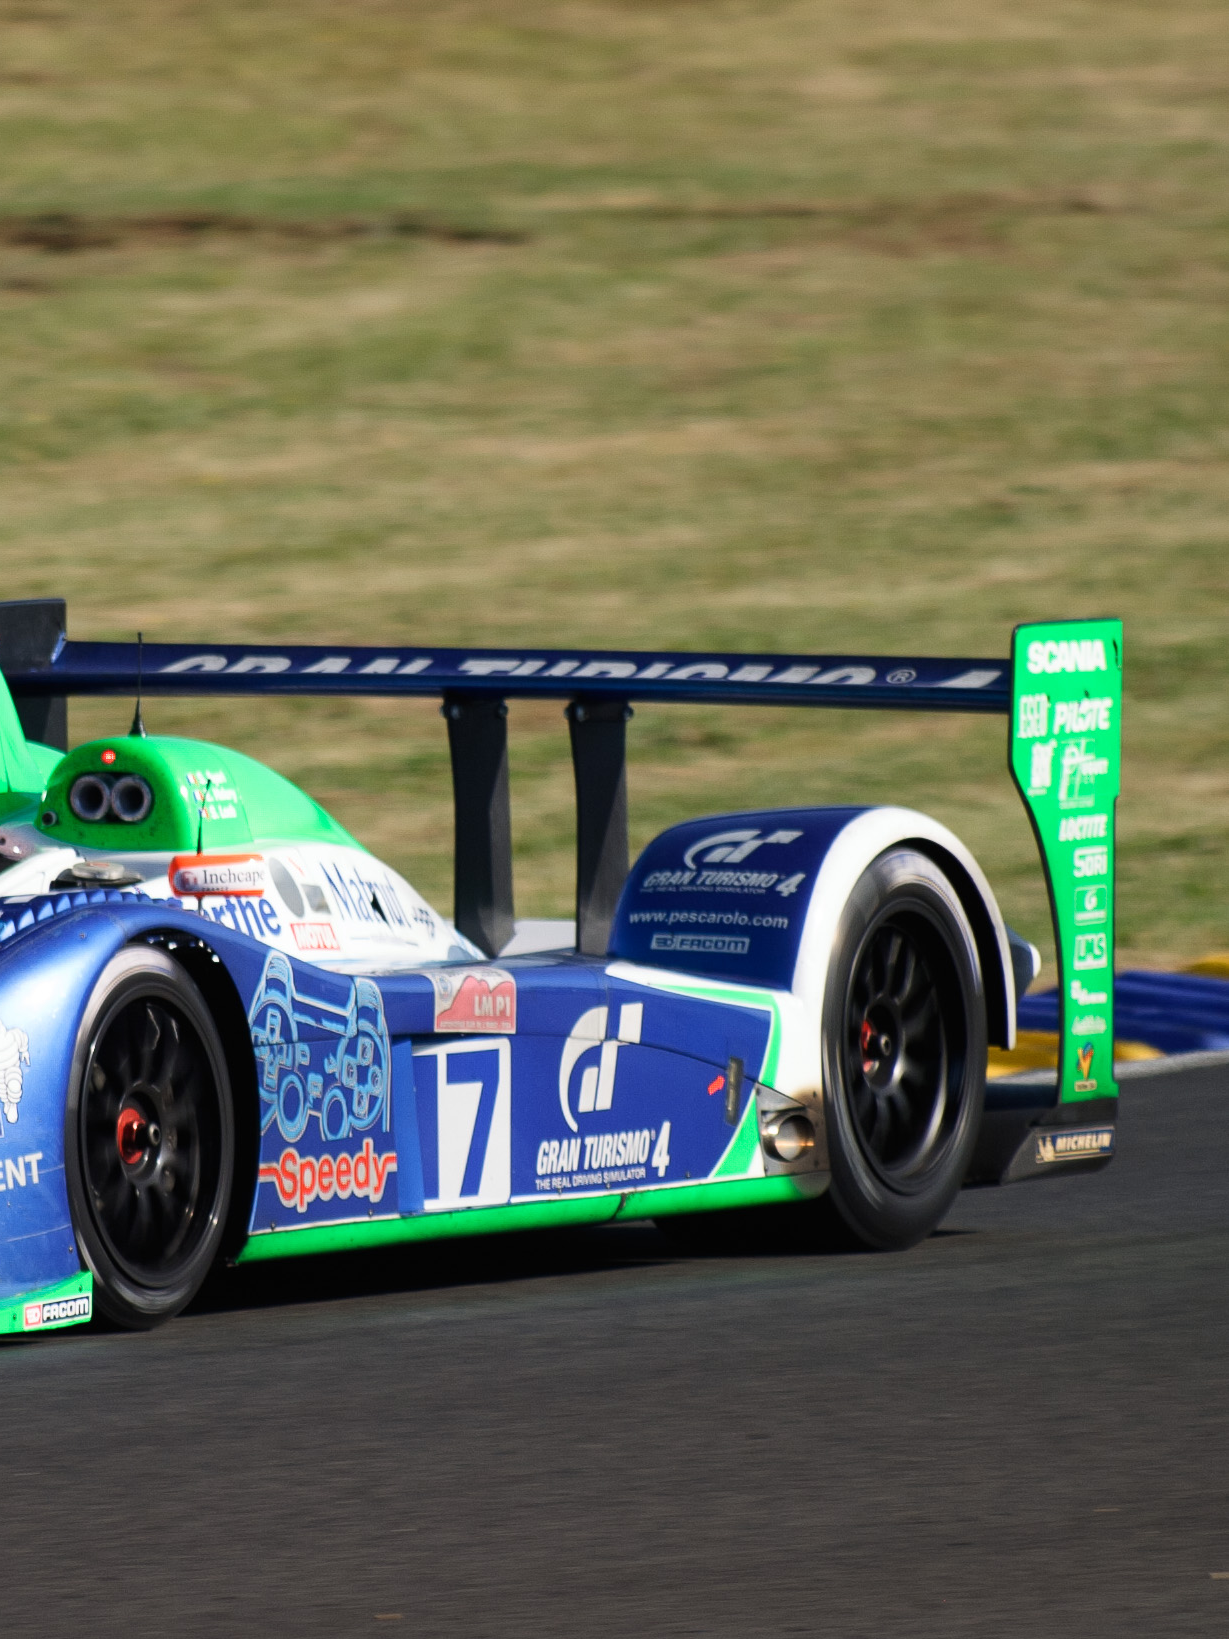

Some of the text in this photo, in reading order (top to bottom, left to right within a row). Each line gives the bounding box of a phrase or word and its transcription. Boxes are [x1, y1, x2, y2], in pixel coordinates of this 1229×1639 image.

[1027, 639, 1107, 674] SCANIA
[643, 870, 806, 897] GRAN TURISMO 4
[629, 910, 789, 930] www.pescarolo.com
[678, 937, 746, 951] FACOM
[536, 1119, 671, 1178] GRAN TURISMO 4
[1055, 1132, 1112, 1151] MICHELIN
[267, 1138, 397, 1212] Speedy
[535, 1167, 647, 1191] THE REAL DRIVING SIMULATOR
[42, 1298, 89, 1321] FACOM
